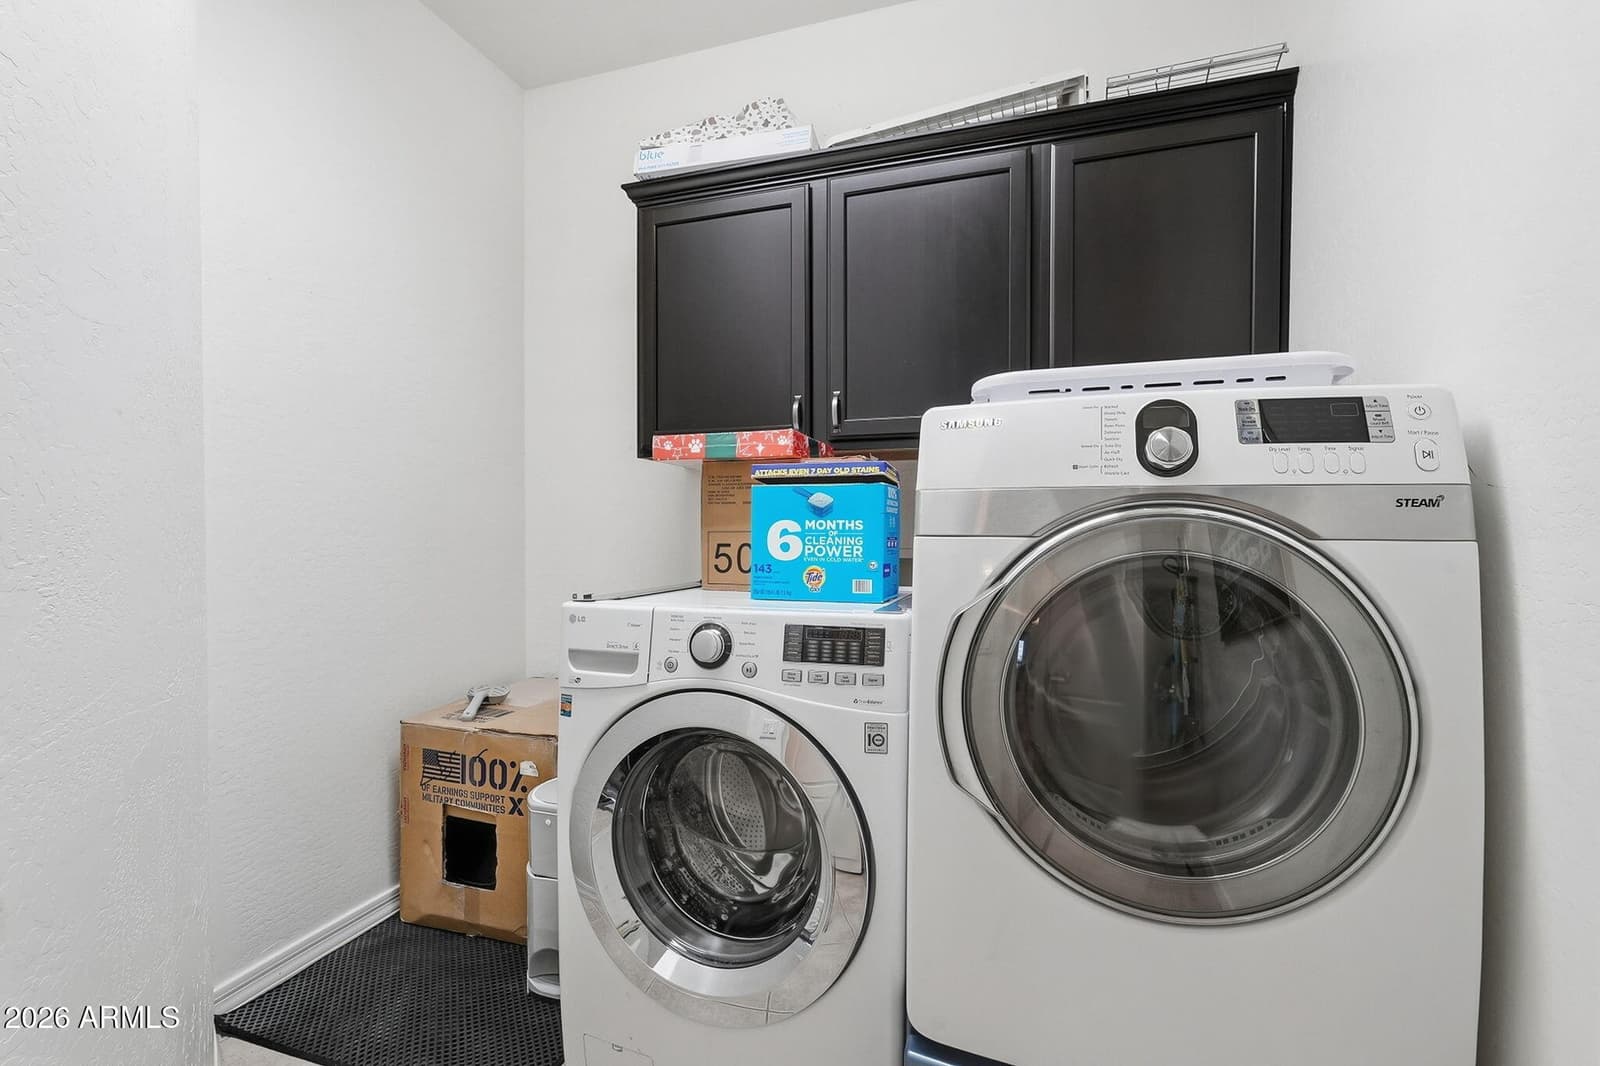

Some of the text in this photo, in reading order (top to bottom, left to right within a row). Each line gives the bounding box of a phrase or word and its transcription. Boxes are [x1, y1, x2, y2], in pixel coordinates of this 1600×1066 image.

[639, 150, 665, 161] blue
[940, 417, 1003, 430] SAMSUNG
[754, 468, 788, 477] ATTACKS
[789, 468, 810, 476] EVEN
[817, 467, 833, 475] DAY
[850, 466, 880, 474] STAINS
[1395, 498, 1441, 508] STEAM
[804, 519, 864, 530] MONTHS
[766, 519, 804, 562] 6
[804, 536, 864, 546] CLEANING
[804, 545, 863, 558] POWER
[753, 563, 773, 574] 143
[806, 570, 823, 585] Tide
[577, 615, 587, 623] LG
[460, 753, 528, 793] 100%
[421, 784, 506, 805] OF EARNINGS SUPPORT
[421, 793, 506, 815] MILITARY COMMUNITIES
[508, 796, 524, 817] X
